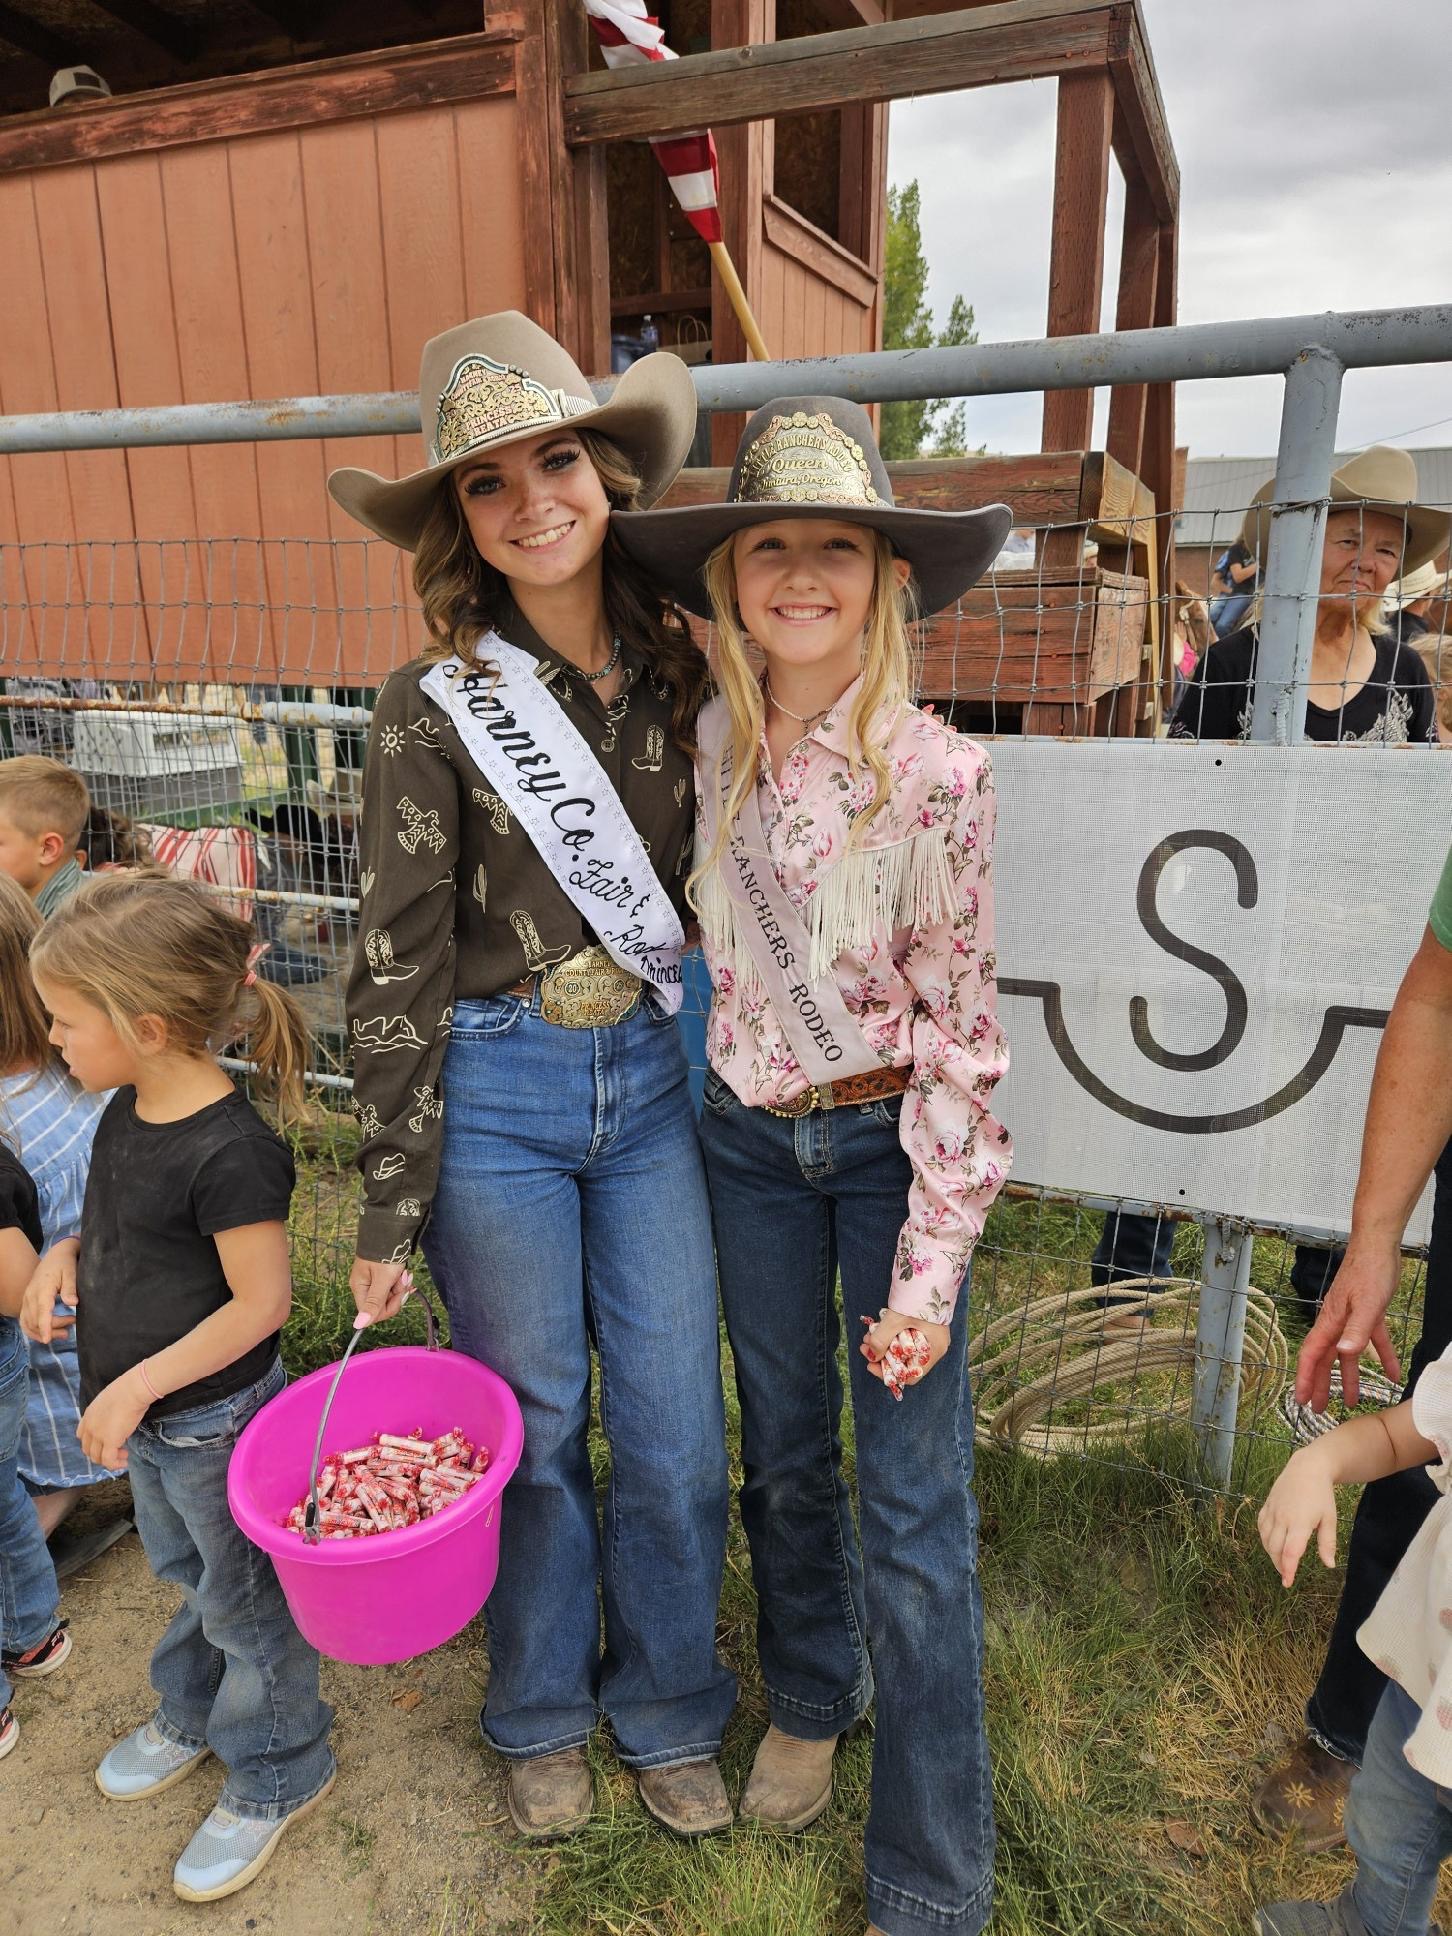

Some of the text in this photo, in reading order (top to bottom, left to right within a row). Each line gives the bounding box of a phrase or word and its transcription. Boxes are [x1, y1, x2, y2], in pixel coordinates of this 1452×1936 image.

[466, 406, 512, 430] PRINCESS
[474, 417, 508, 437] REATA
[772, 459, 828, 474] Queen
[776, 434, 828, 452] RANCHERS
[827, 443, 855, 472] RODEO
[801, 473, 841, 488] Oregon
[442, 664, 567, 802] Harney
[550, 797, 596, 862] Co.
[569, 859, 634, 908] Fair
[730, 835, 797, 970] RANCHERS
[788, 982, 844, 1064] RODEO
